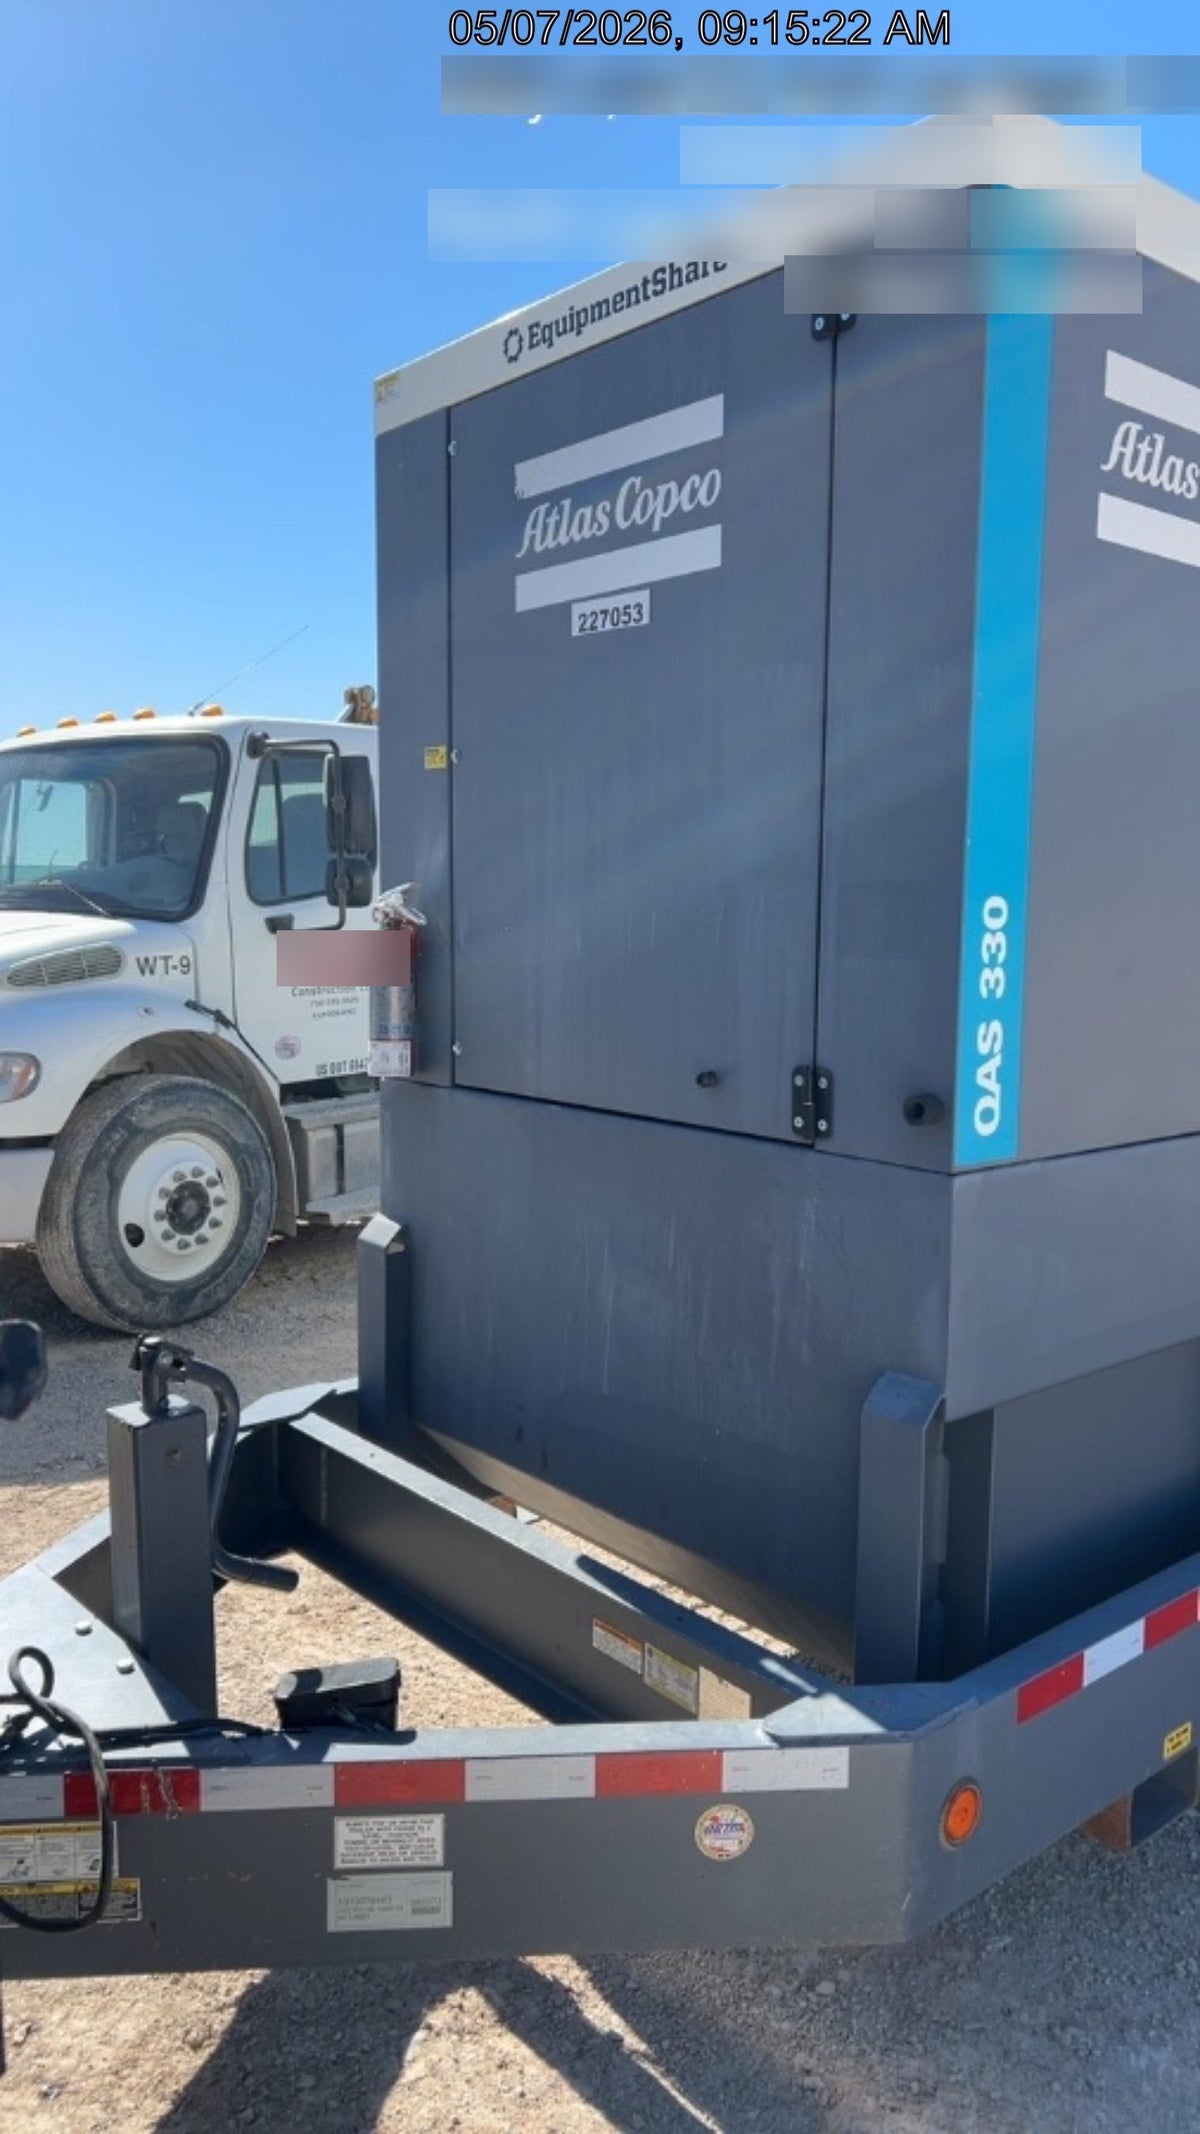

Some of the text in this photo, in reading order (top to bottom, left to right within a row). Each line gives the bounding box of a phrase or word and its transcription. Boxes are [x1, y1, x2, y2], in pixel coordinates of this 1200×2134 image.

[1100, 421, 1200, 499] Atlas
[515, 468, 722, 559] Atlas Copco
[577, 602, 644, 634] 227053
[134, 954, 191, 977] WT-9
[973, 895, 1009, 1137] QAS 330
